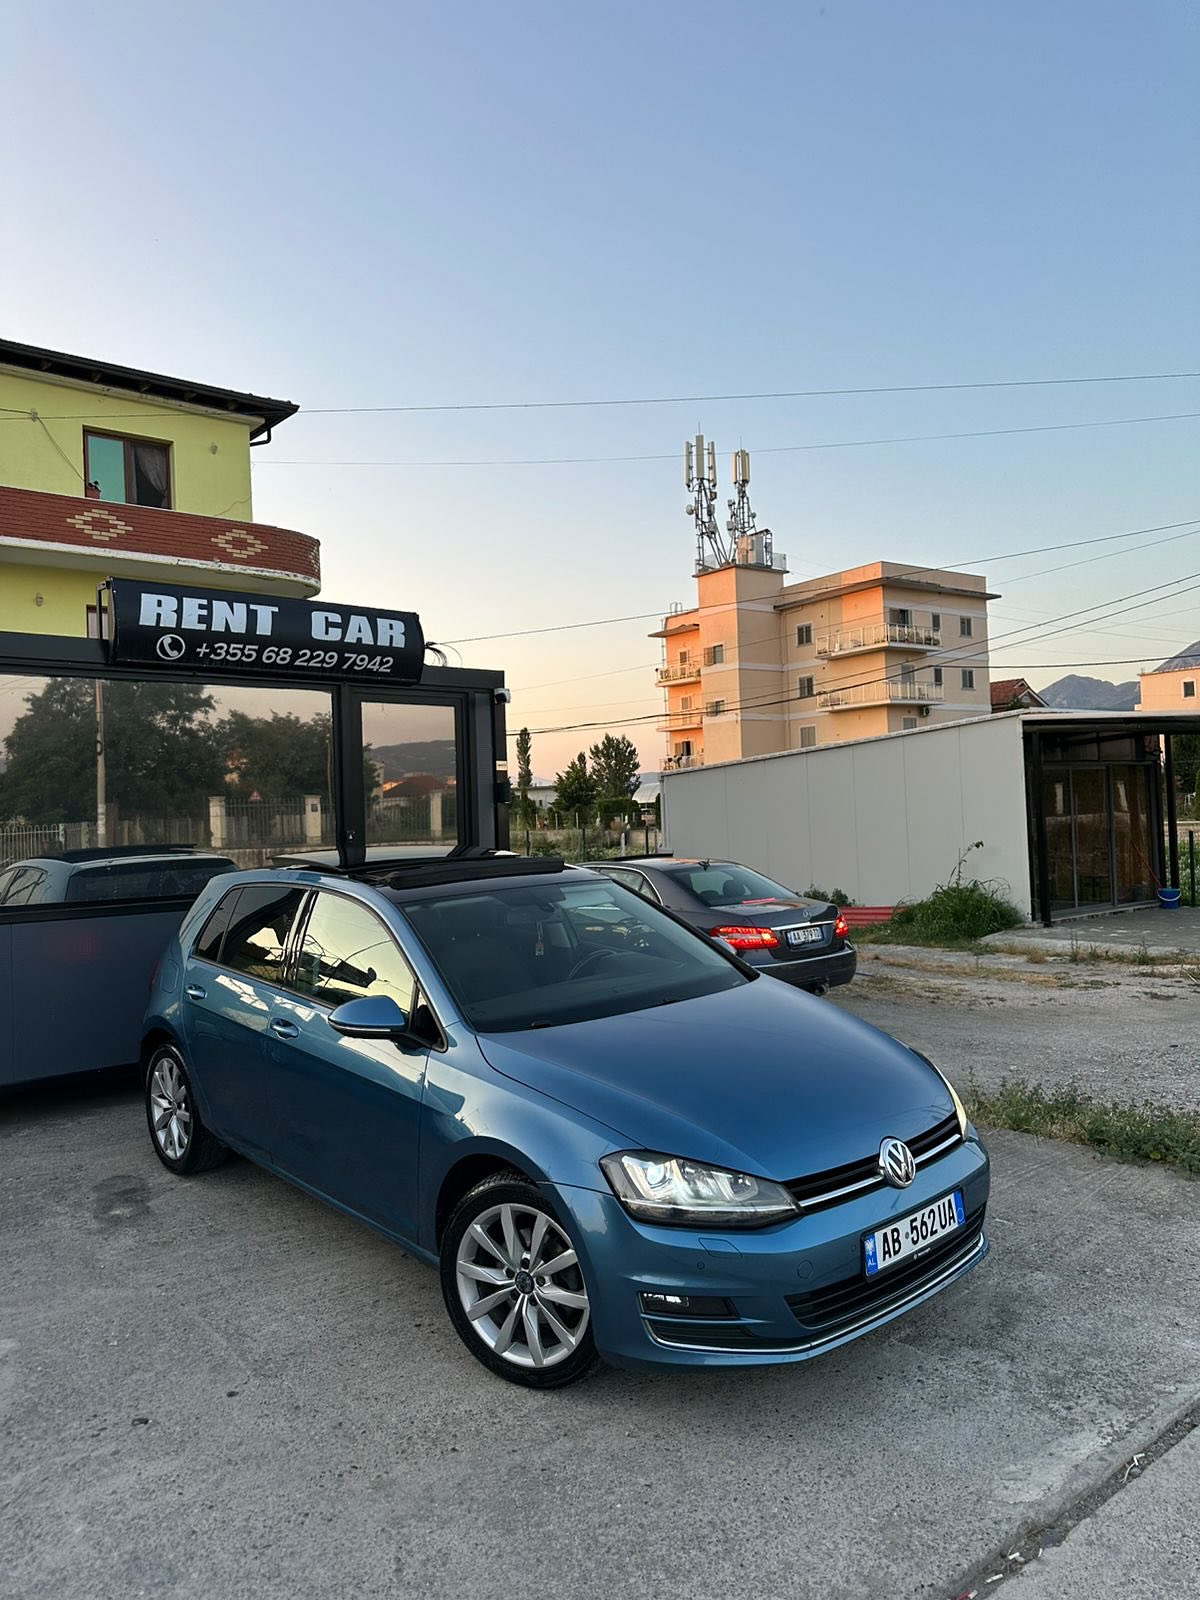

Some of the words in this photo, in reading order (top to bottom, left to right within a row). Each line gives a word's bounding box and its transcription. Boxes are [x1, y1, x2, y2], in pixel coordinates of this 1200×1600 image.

[139, 592, 279, 636] RENT
[311, 611, 406, 648] CAR
[195, 643, 259, 662] +355
[262, 646, 292, 665] 68
[294, 650, 338, 669] 229
[343, 652, 394, 673] 7942
[882, 1227, 902, 1262] AB
[867, 1257, 876, 1267] AL
